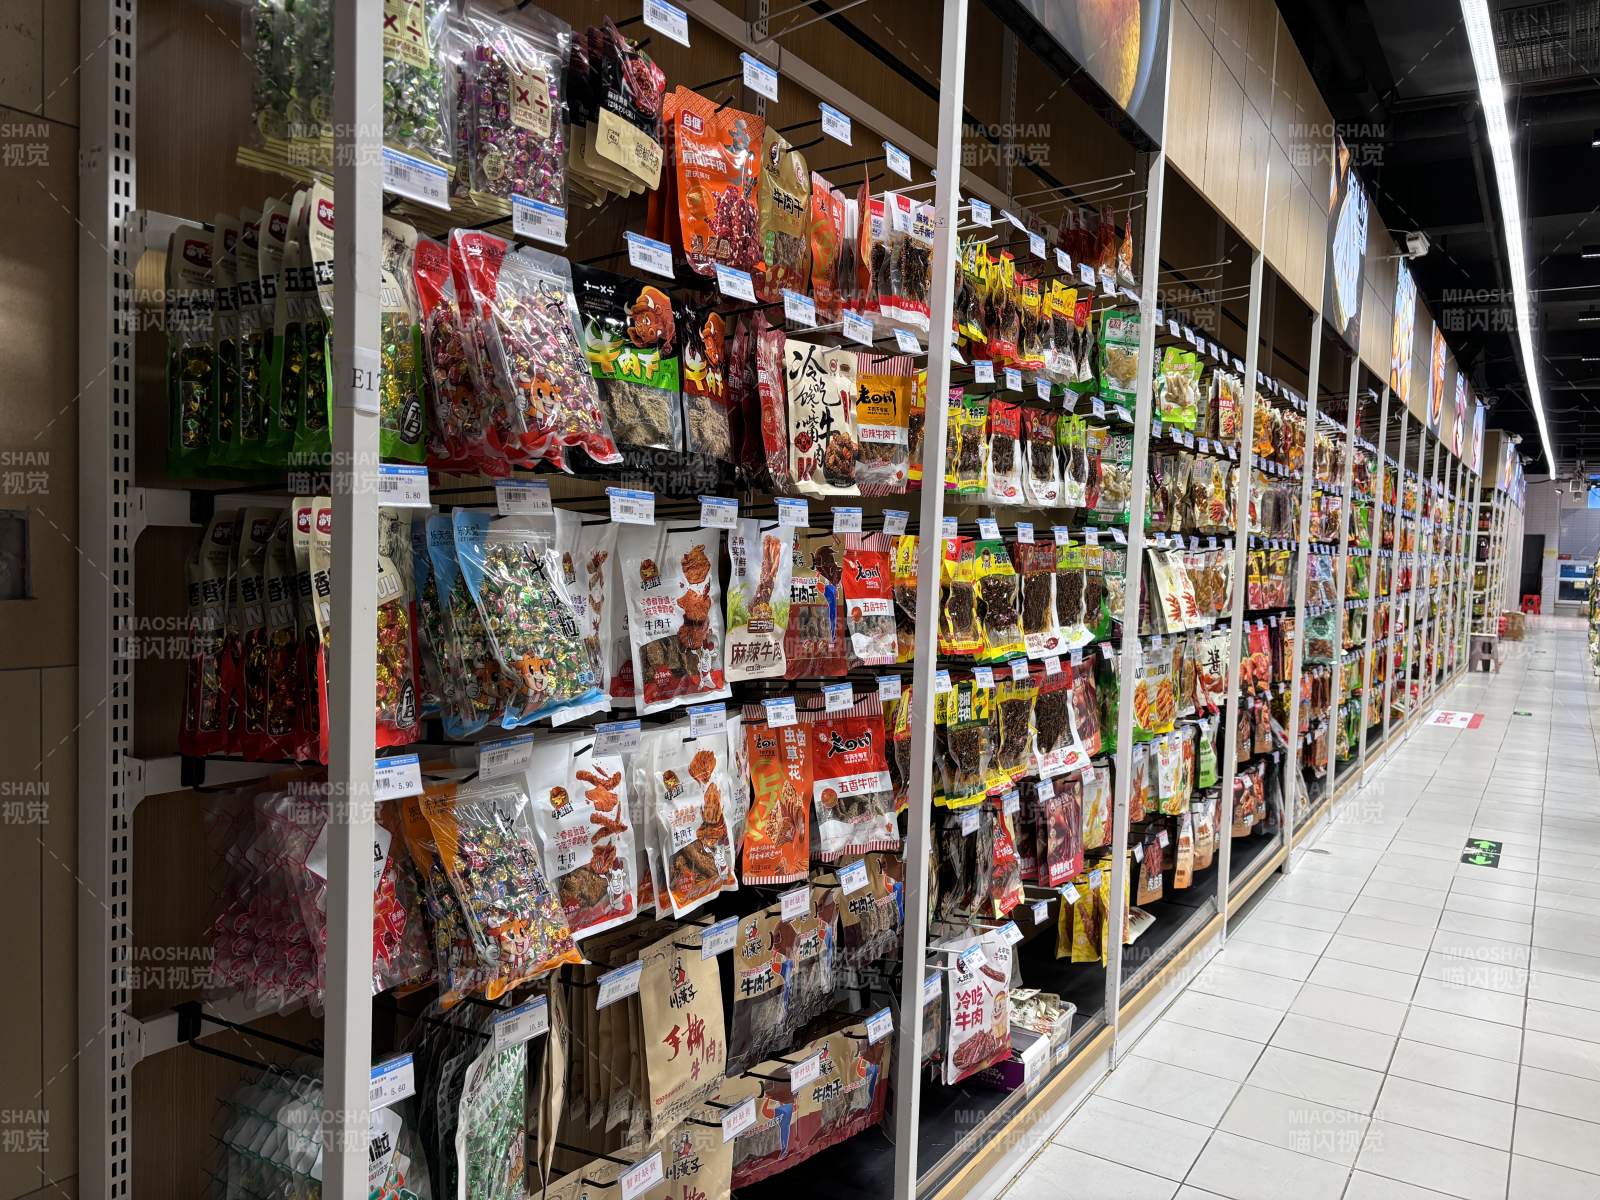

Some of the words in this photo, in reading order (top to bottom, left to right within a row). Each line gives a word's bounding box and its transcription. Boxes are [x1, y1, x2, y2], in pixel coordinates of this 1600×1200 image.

[351, 367, 380, 392] E1
[405, 491, 421, 499] 5.80
[645, 619, 671, 631] 牛肉干
[731, 640, 783, 665] 麻辣牛肉
[398, 781, 414, 790] 5.90
[740, 970, 775, 996] 牛肉干
[955, 985, 985, 1010] 冷吃
[954, 1007, 984, 1032] 牛肉
[813, 1078, 843, 1102] 牛肉干
